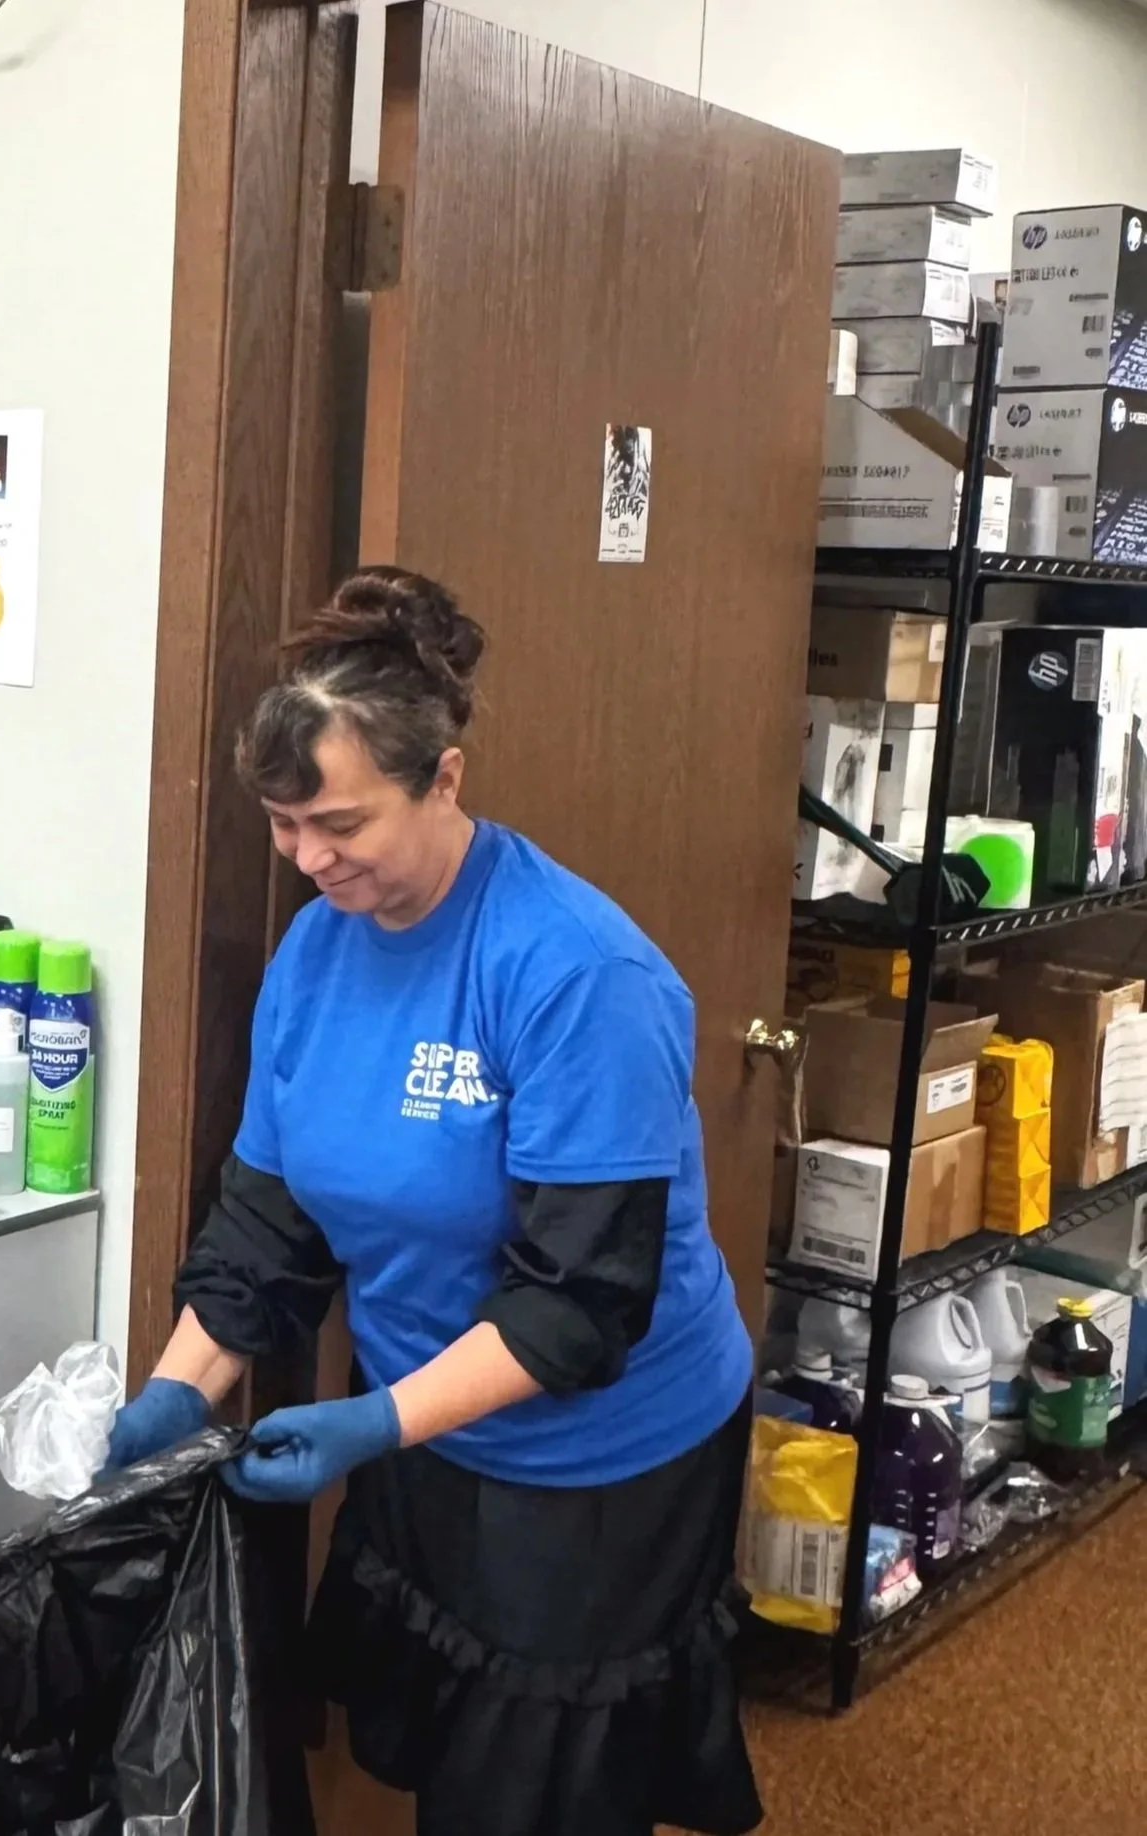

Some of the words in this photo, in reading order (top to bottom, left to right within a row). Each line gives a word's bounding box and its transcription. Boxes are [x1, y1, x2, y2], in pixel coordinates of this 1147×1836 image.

[1028, 651, 1069, 686] hp
[43, 1053, 79, 1064] HOUR
[405, 1067, 490, 1107] CLEAN
